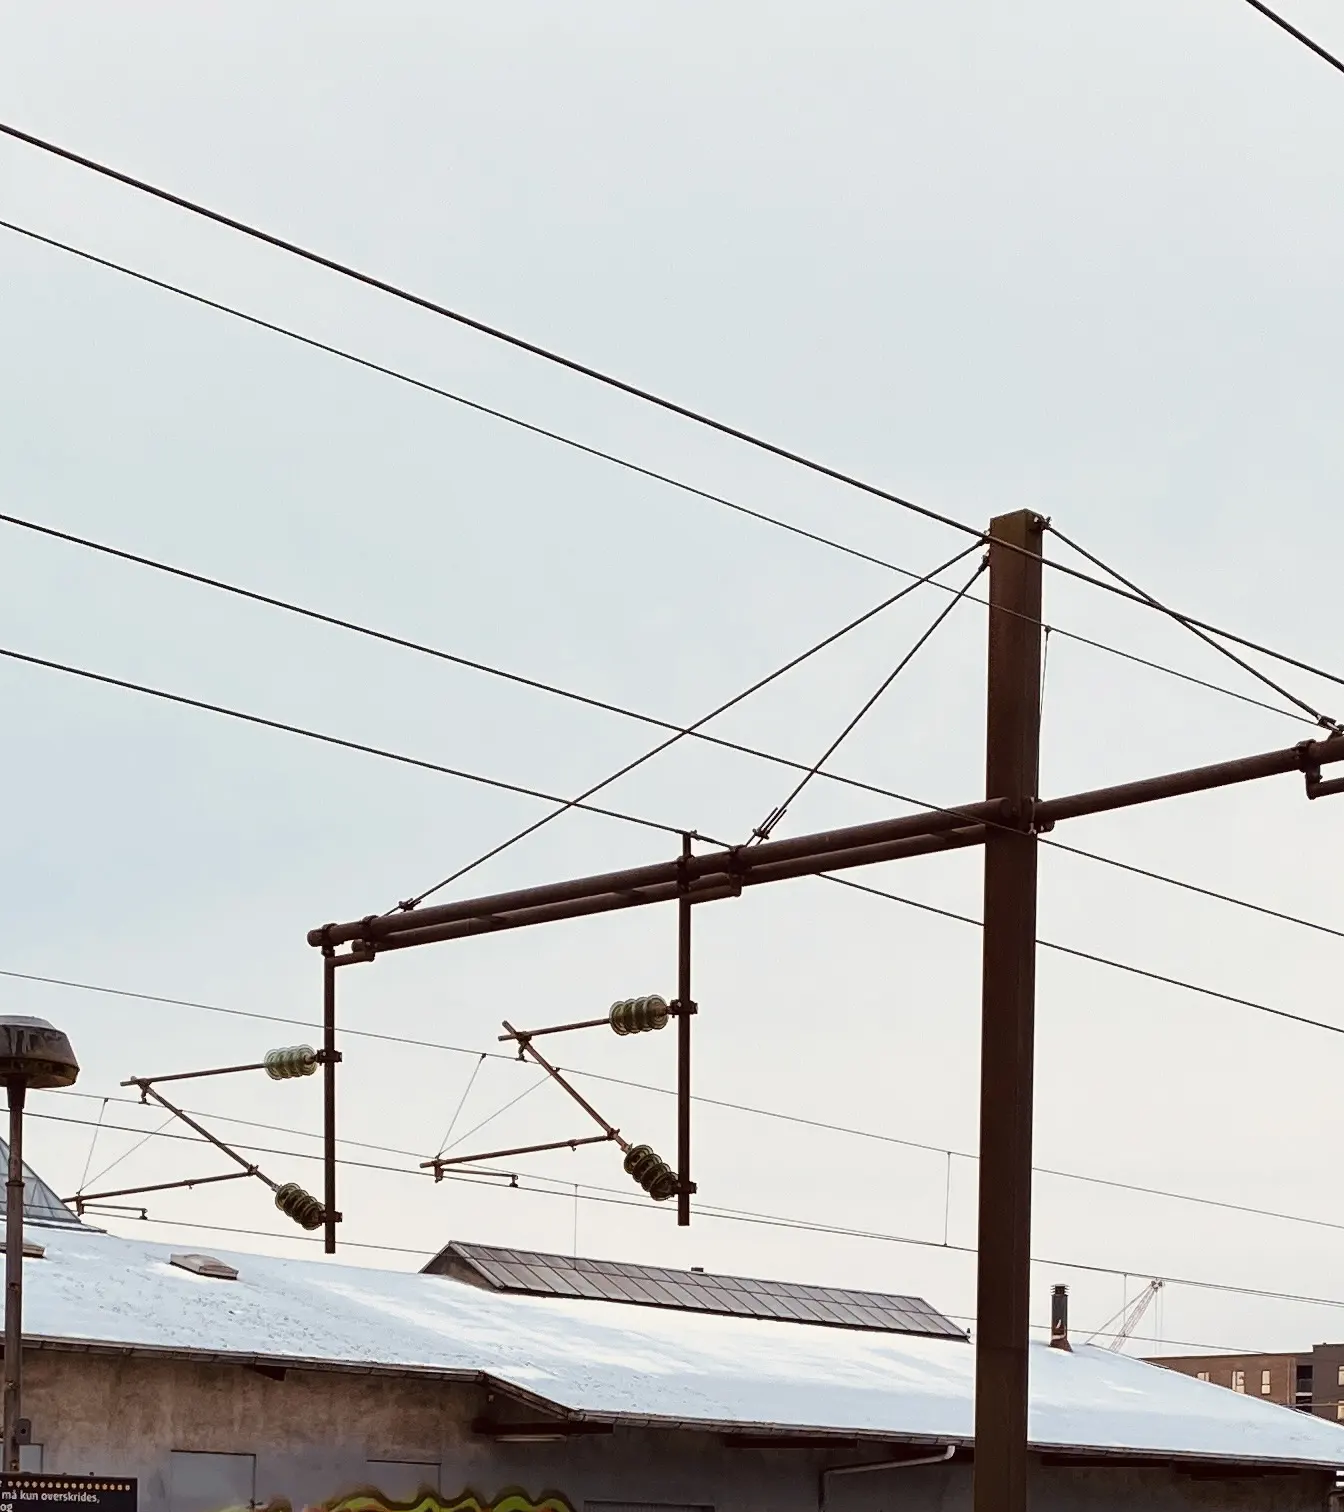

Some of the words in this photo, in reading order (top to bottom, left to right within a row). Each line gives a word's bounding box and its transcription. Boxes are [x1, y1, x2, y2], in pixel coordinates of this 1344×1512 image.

[1, 1489, 17, 1500] må
[19, 1490, 39, 1501] kun
[41, 1491, 101, 1504] overskrides,
